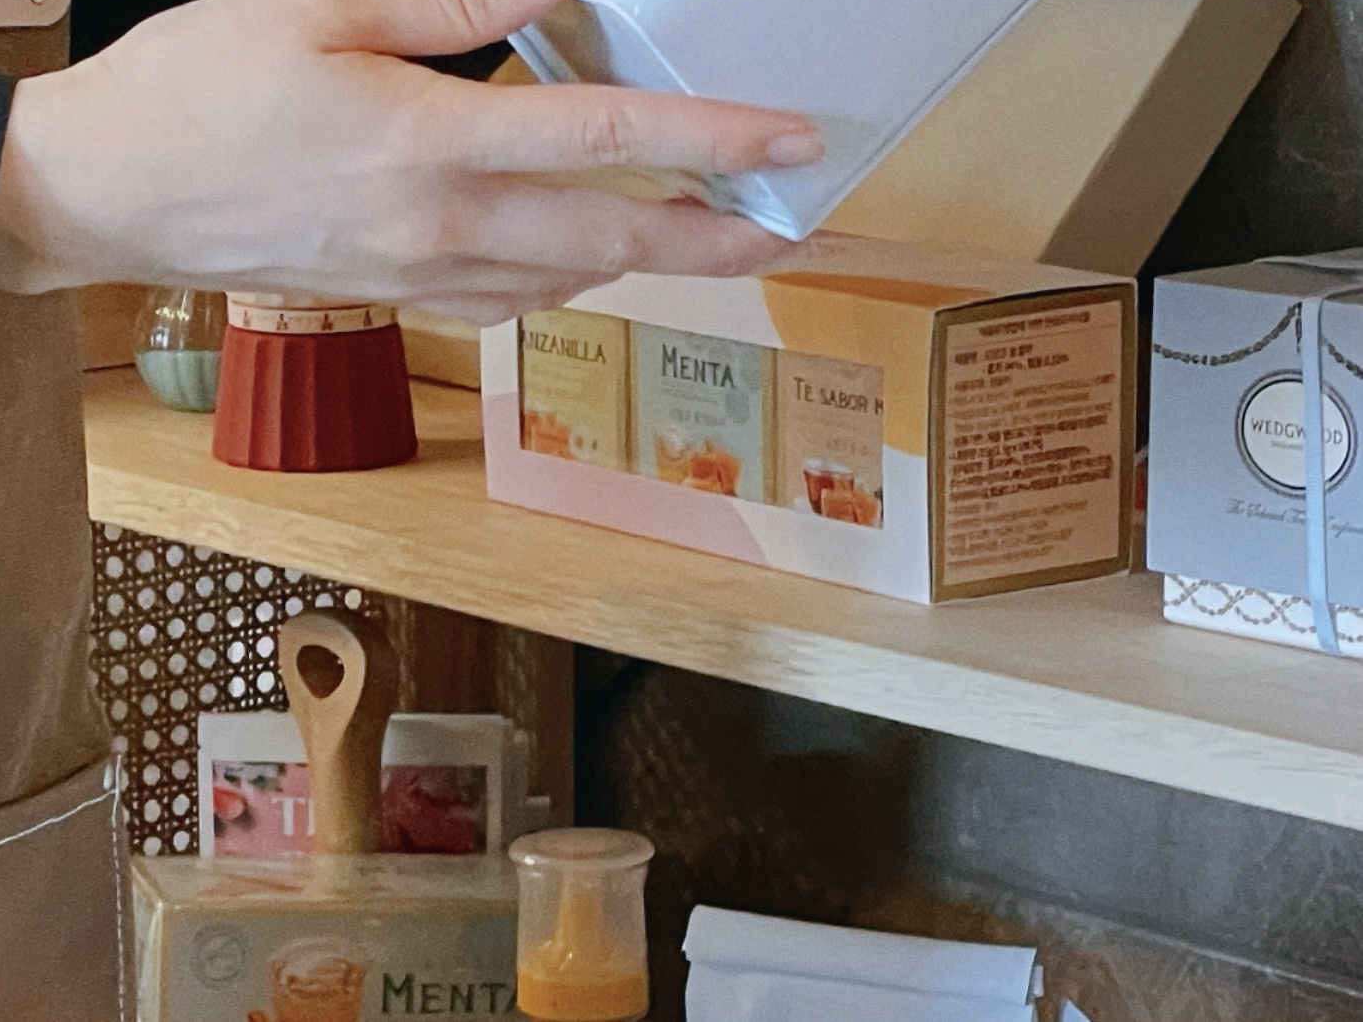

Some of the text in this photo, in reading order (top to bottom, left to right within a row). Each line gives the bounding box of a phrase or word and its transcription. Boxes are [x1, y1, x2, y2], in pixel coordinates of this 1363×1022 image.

[662, 342, 735, 389] MENTA
[793, 376, 815, 403] TE
[819, 386, 868, 413] SABOR
[1251, 417, 1343, 445] WEDGWOD
